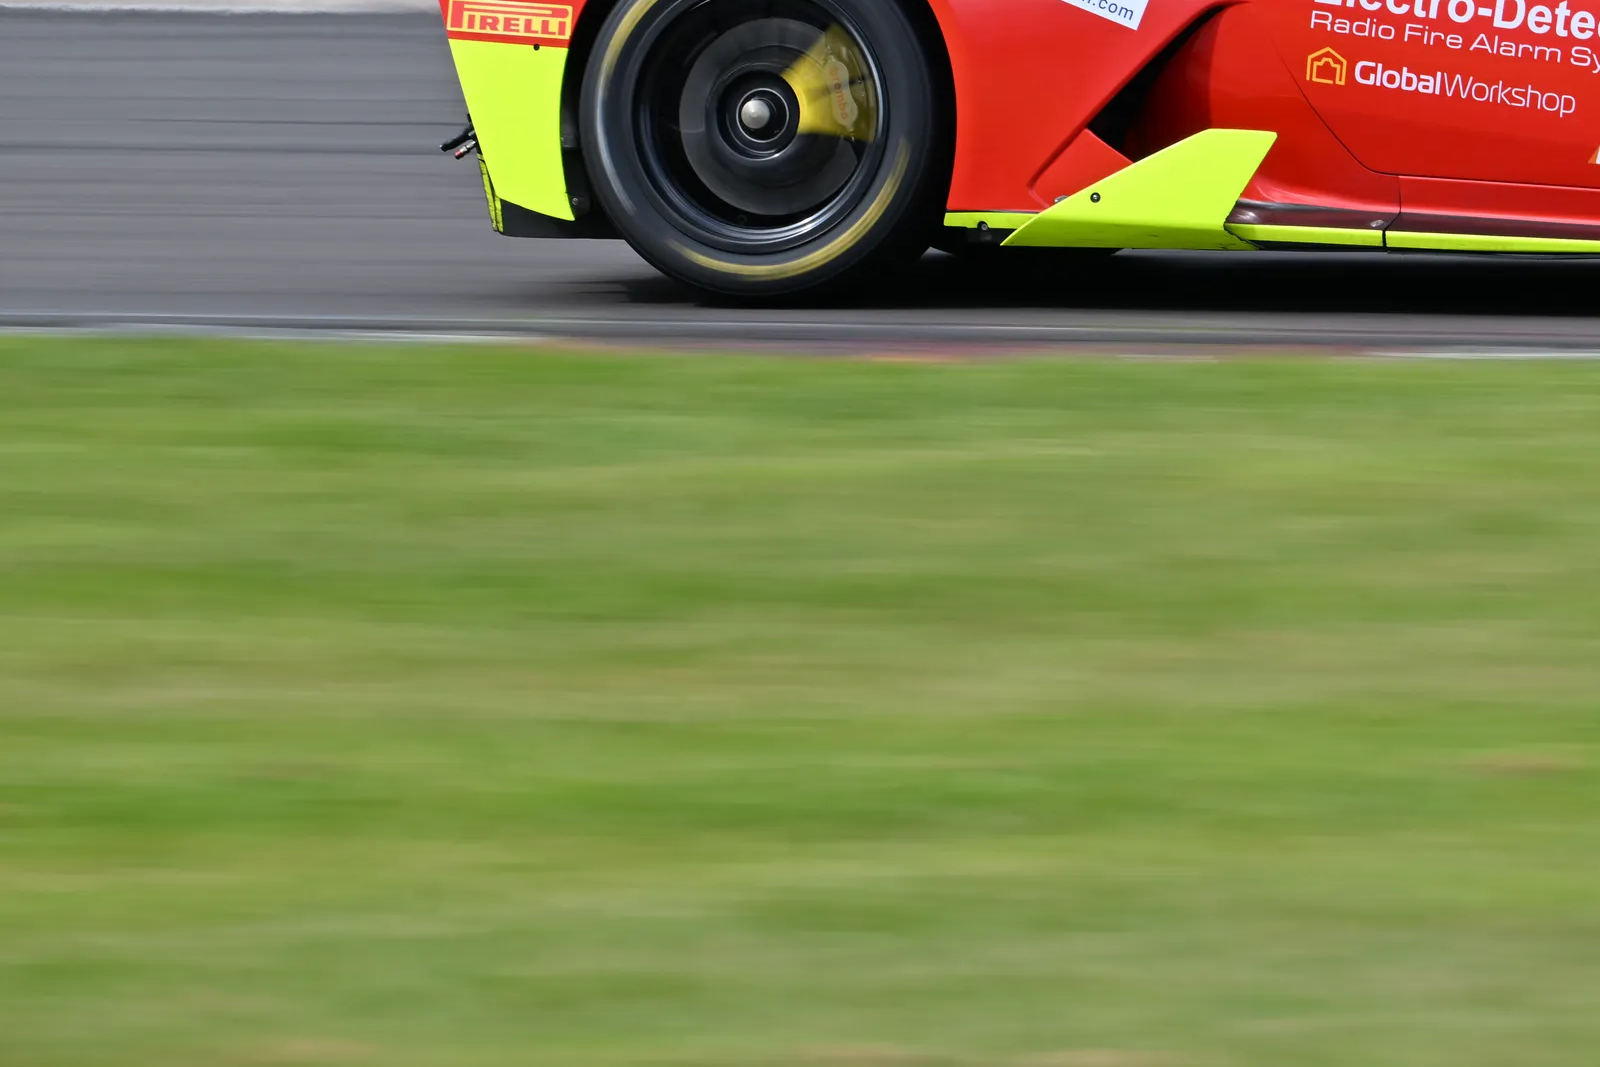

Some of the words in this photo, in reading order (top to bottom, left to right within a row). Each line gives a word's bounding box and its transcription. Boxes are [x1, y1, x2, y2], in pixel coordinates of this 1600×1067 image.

[450, 0, 569, 37] PIRELLI
[1310, 10, 1395, 40] Radio
[1404, 23, 1463, 49] Fire
[1469, 33, 1561, 63] Alarm
